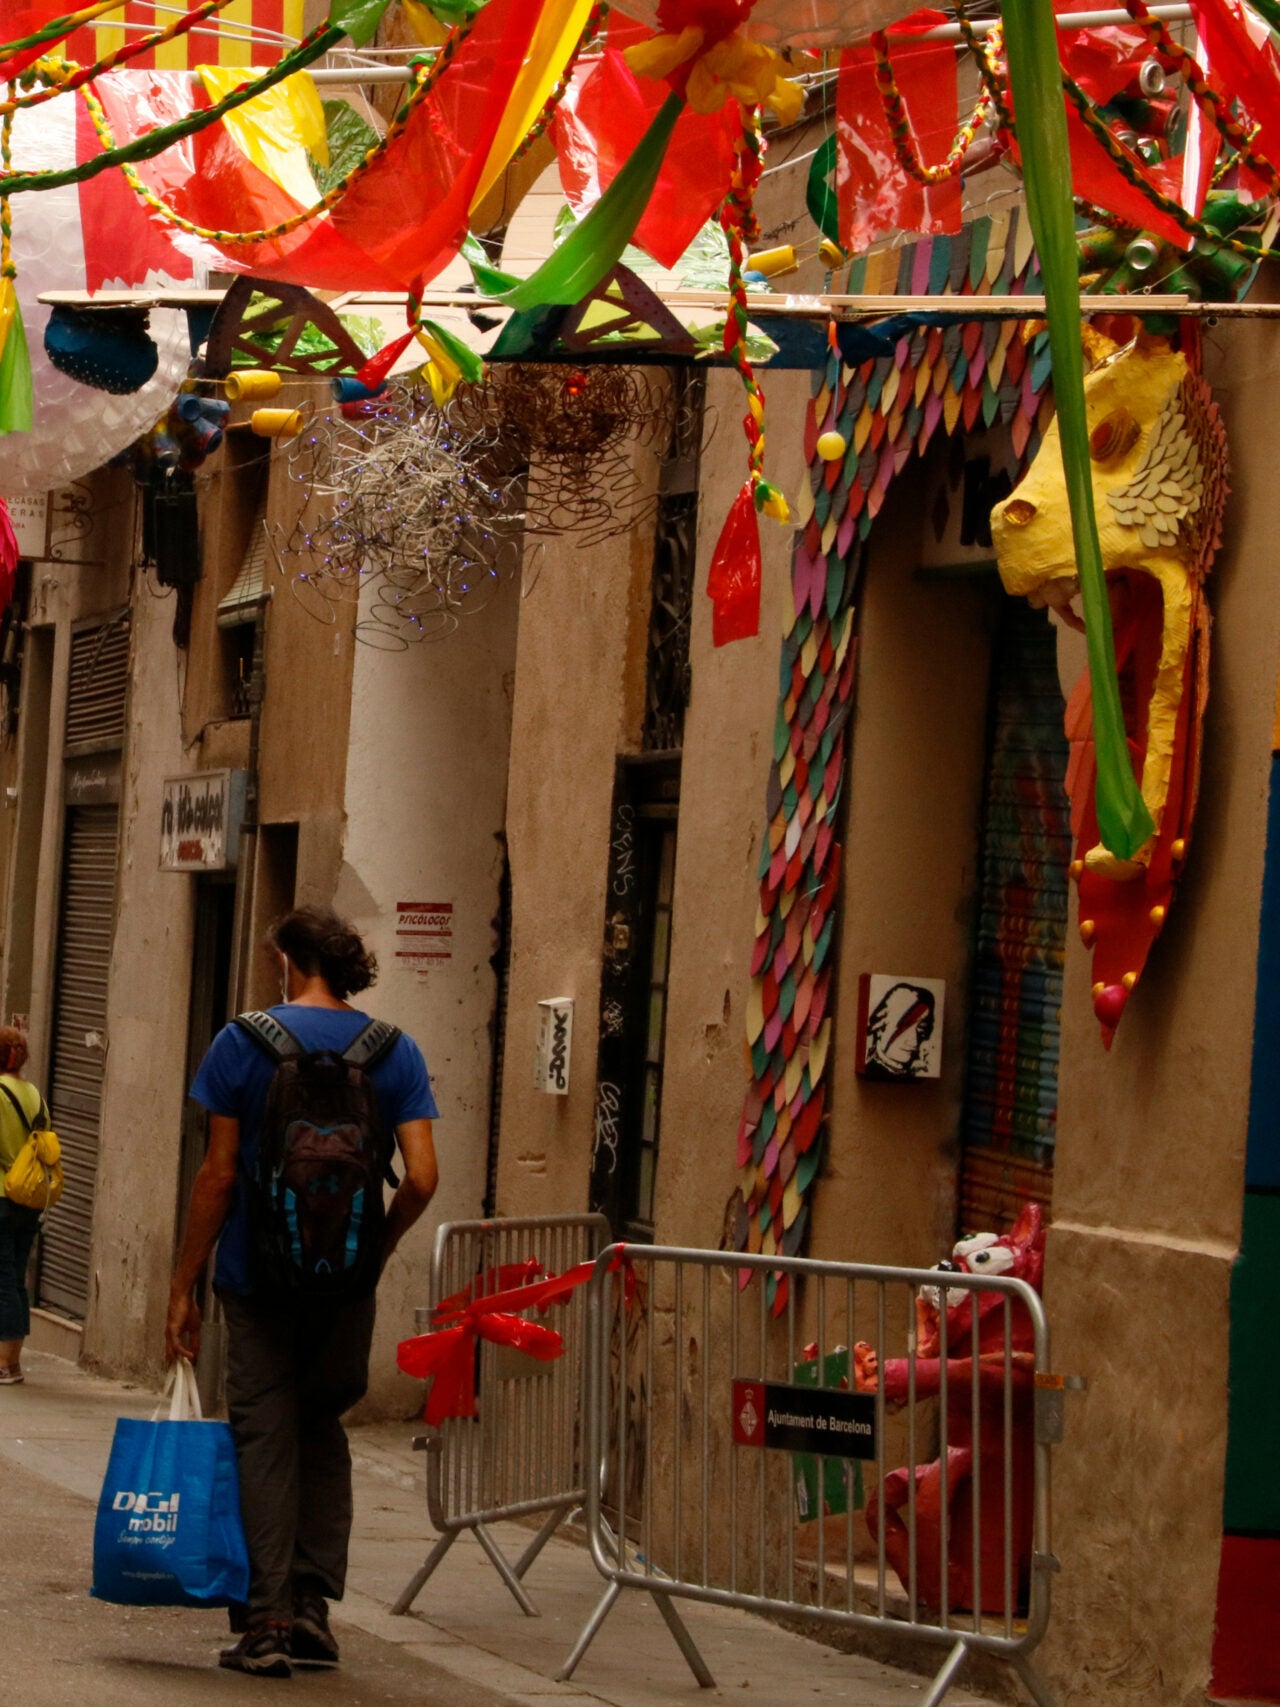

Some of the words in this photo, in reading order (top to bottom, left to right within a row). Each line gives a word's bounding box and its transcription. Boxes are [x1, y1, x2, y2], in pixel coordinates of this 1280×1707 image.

[768, 1409, 814, 1429] Ajuntament
[816, 1415, 828, 1430] de
[829, 1416, 872, 1435] Barcelona
[128, 1513, 178, 1532] mobil
